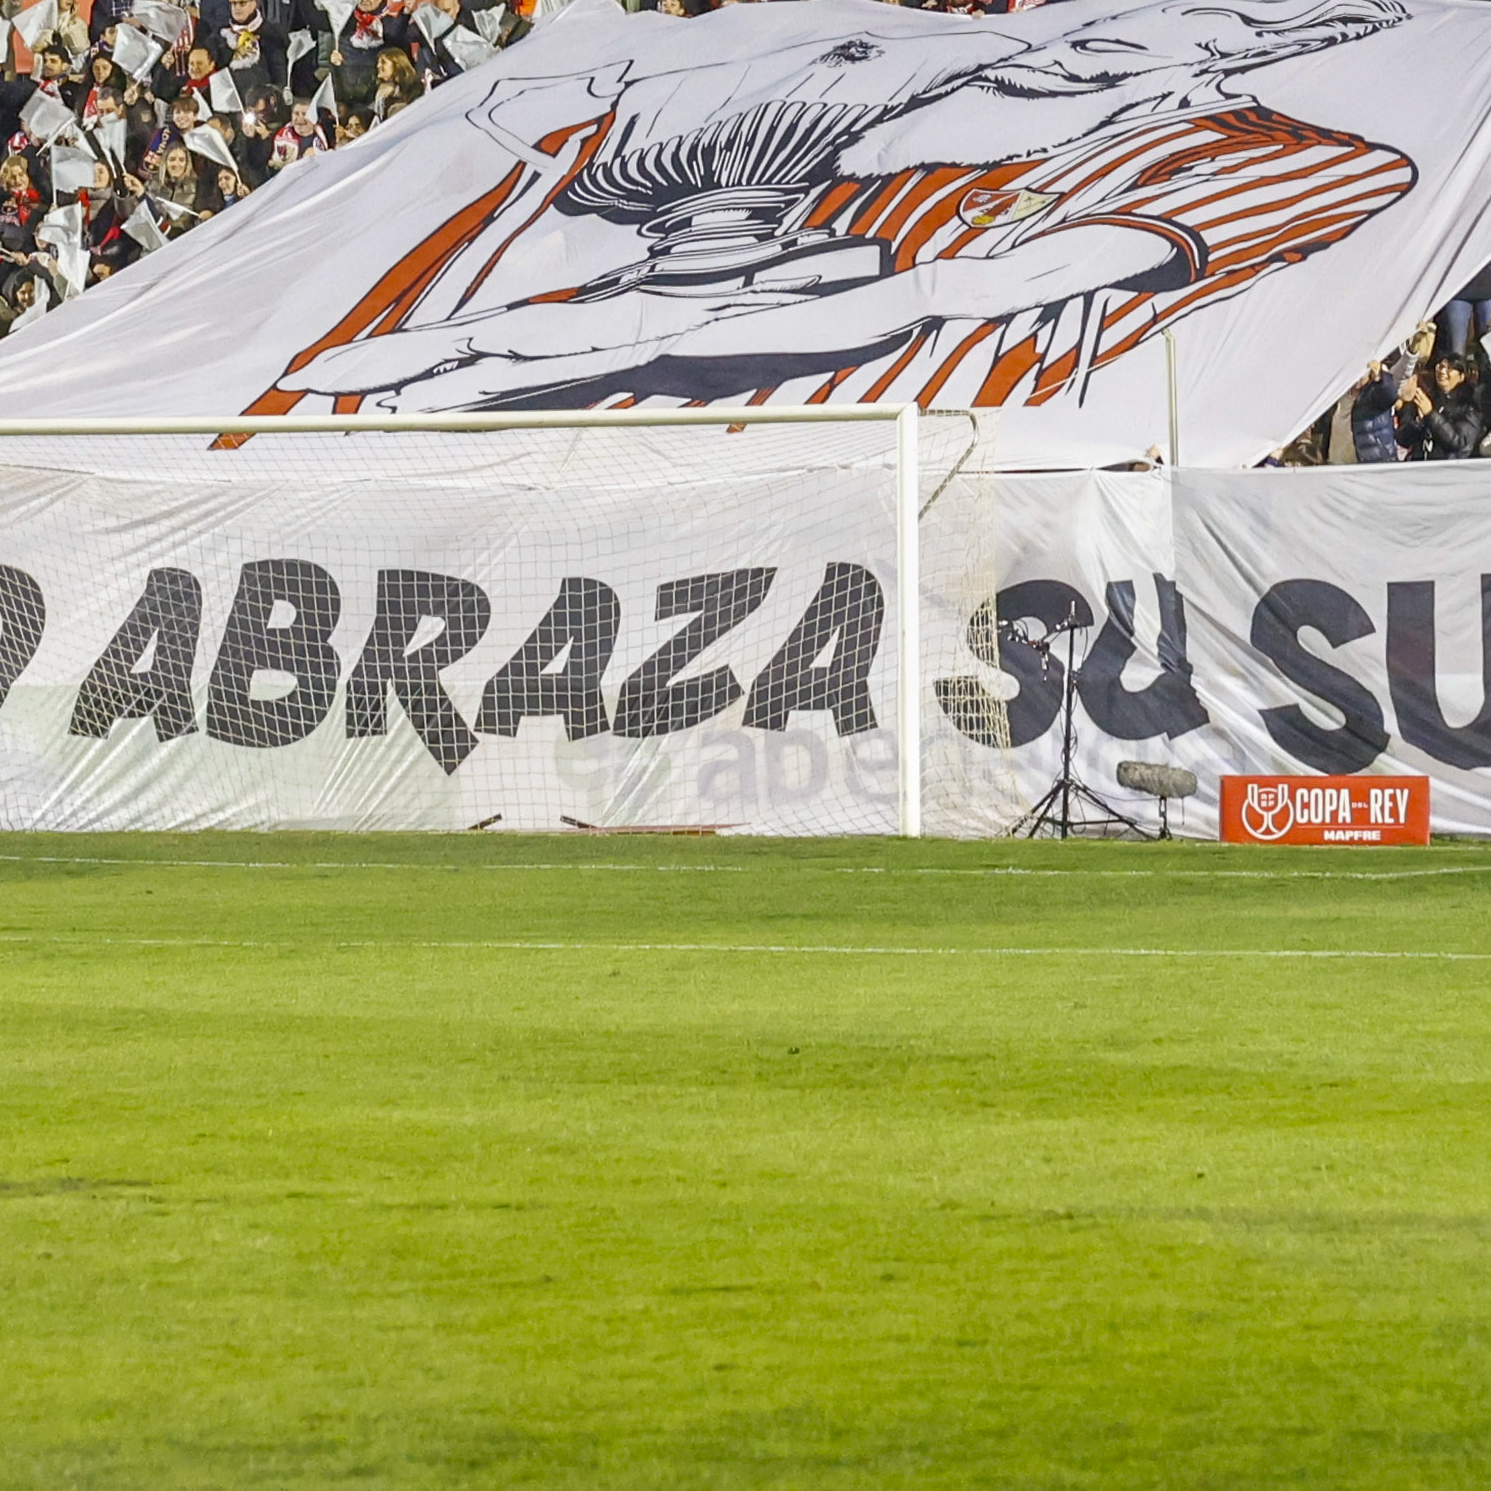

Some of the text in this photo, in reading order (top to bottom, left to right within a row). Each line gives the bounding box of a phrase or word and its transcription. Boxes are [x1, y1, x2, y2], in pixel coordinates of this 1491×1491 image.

[69, 557, 886, 777] ABRAZA
[1295, 788, 1352, 824] COPA
[1369, 788, 1409, 824] REY
[1323, 830, 1382, 841] MAPFRE
